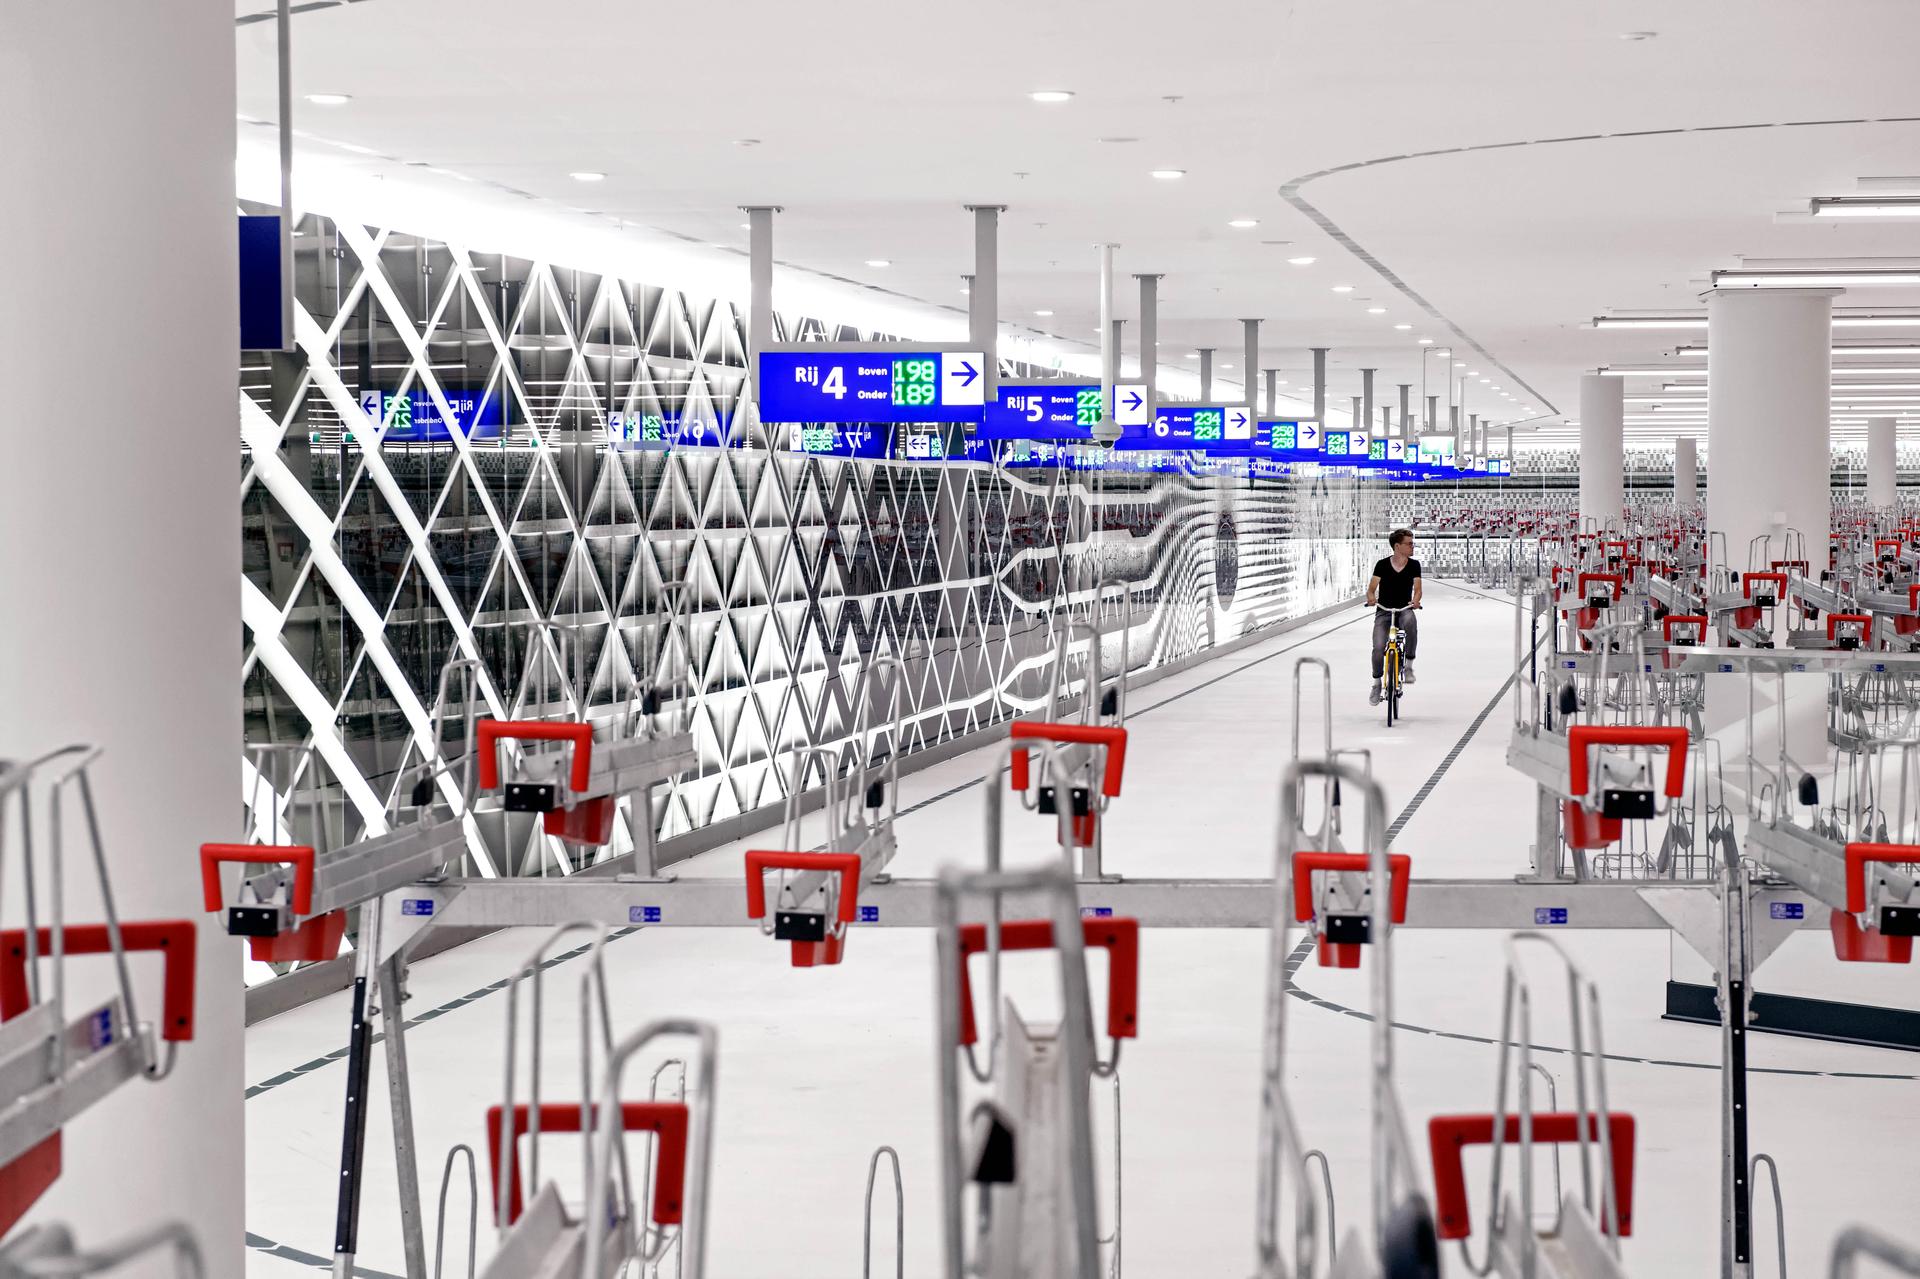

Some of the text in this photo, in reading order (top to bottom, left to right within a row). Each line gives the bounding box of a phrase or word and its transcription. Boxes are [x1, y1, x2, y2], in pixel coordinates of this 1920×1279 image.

[858, 361, 935, 382] Boven 198
[795, 366, 847, 399] Rij 4
[857, 384, 935, 405] Onder 189
[1007, 396, 1043, 422] Rij 5
[1077, 409, 1102, 425] 21
[1155, 416, 1169, 437] 6
[1193, 412, 1220, 426] 234
[1193, 426, 1220, 440] 234
[1272, 426, 1295, 437] 250
[1272, 438, 1295, 449] 250
